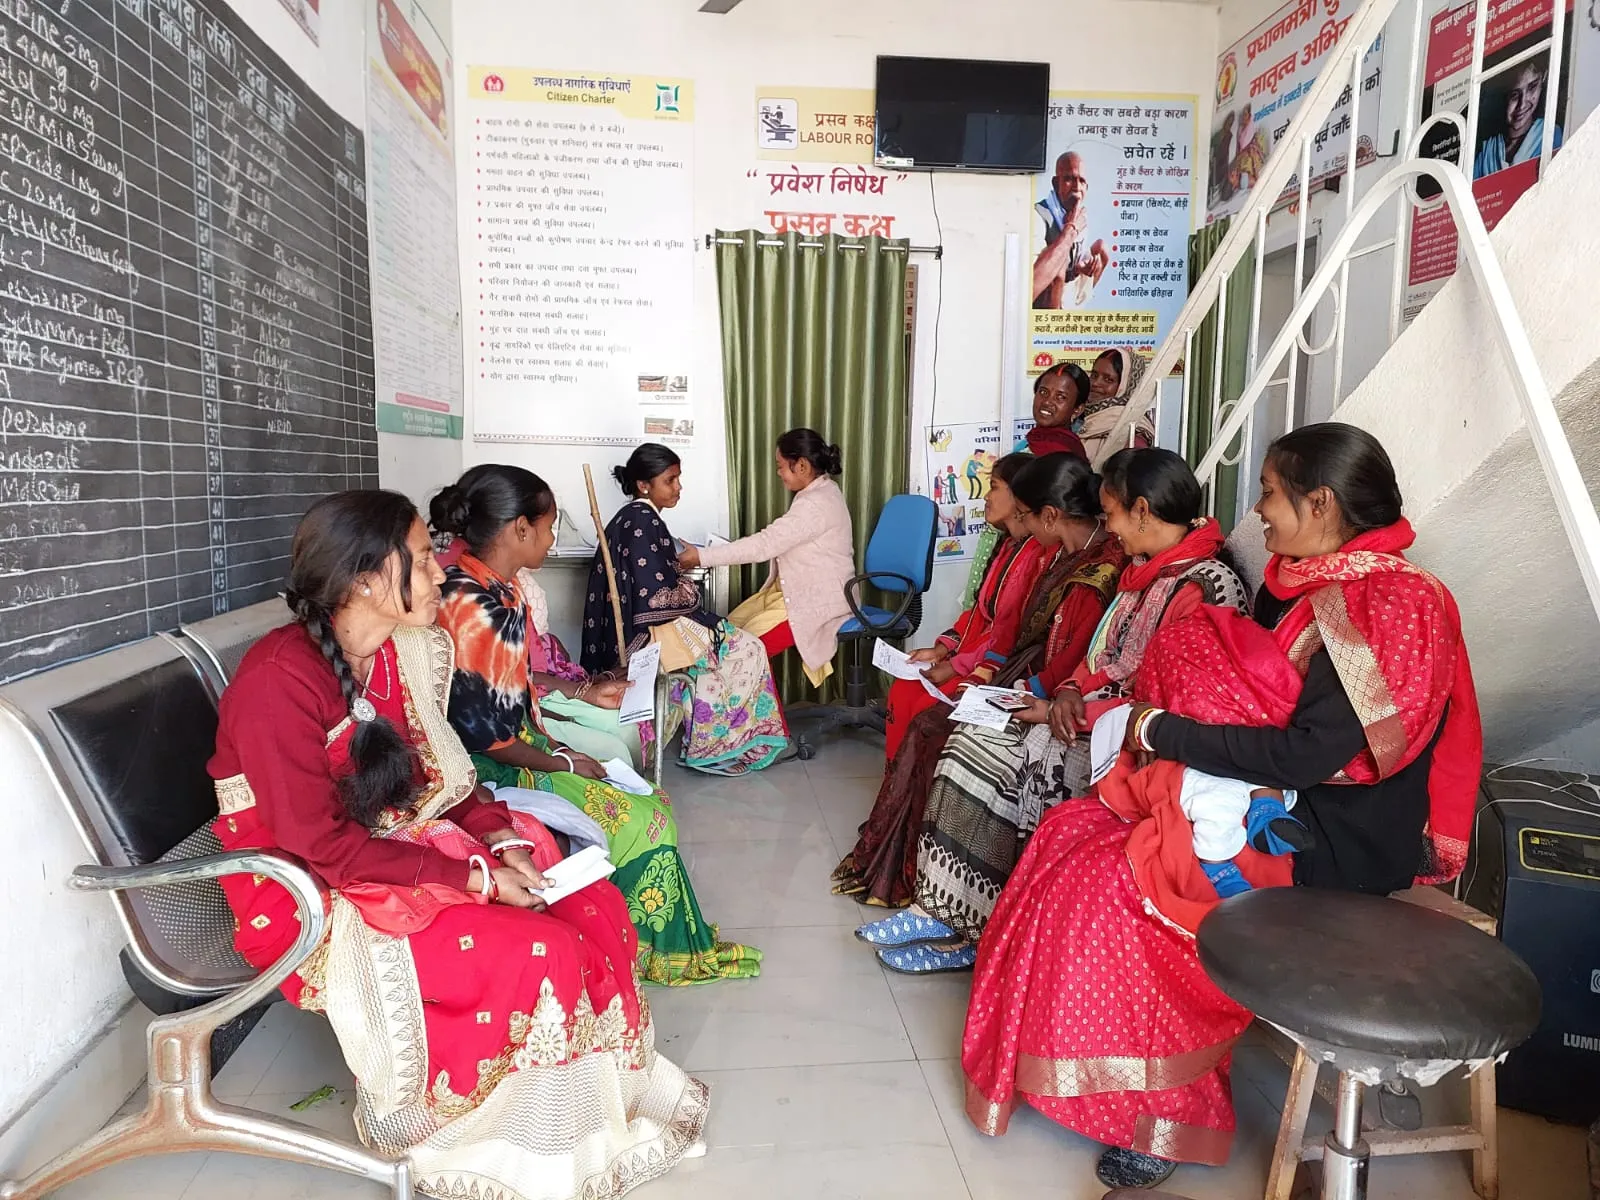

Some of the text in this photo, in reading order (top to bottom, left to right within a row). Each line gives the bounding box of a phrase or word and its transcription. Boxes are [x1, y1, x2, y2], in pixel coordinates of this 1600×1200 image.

[533, 76, 563, 89] उपलब्ध
[565, 76, 596, 89] नागरिक
[546, 91, 616, 104] Citizen Charter
[1065, 104, 1075, 115] के
[1103, 107, 1114, 117] का
[1118, 106, 1142, 117] सबसे
[1164, 109, 1188, 119] कारण
[814, 112, 848, 127] प्रसव
[1077, 123, 1158, 138] तम्बाकू का सेवन है
[800, 132, 852, 145] LABOUR
[1123, 142, 1176, 160] सचेत रहें
[1130, 165, 1136, 176] के
[1156, 166, 1163, 176] के
[766, 164, 887, 197] प्रवेश निषेध
[1117, 180, 1123, 190] के
[1153, 227, 1168, 237] सेवन
[1148, 243, 1164, 252] सेवन
[1044, 314, 1049, 322] 5
[1564, 1032, 1600, 1052] LUMI
